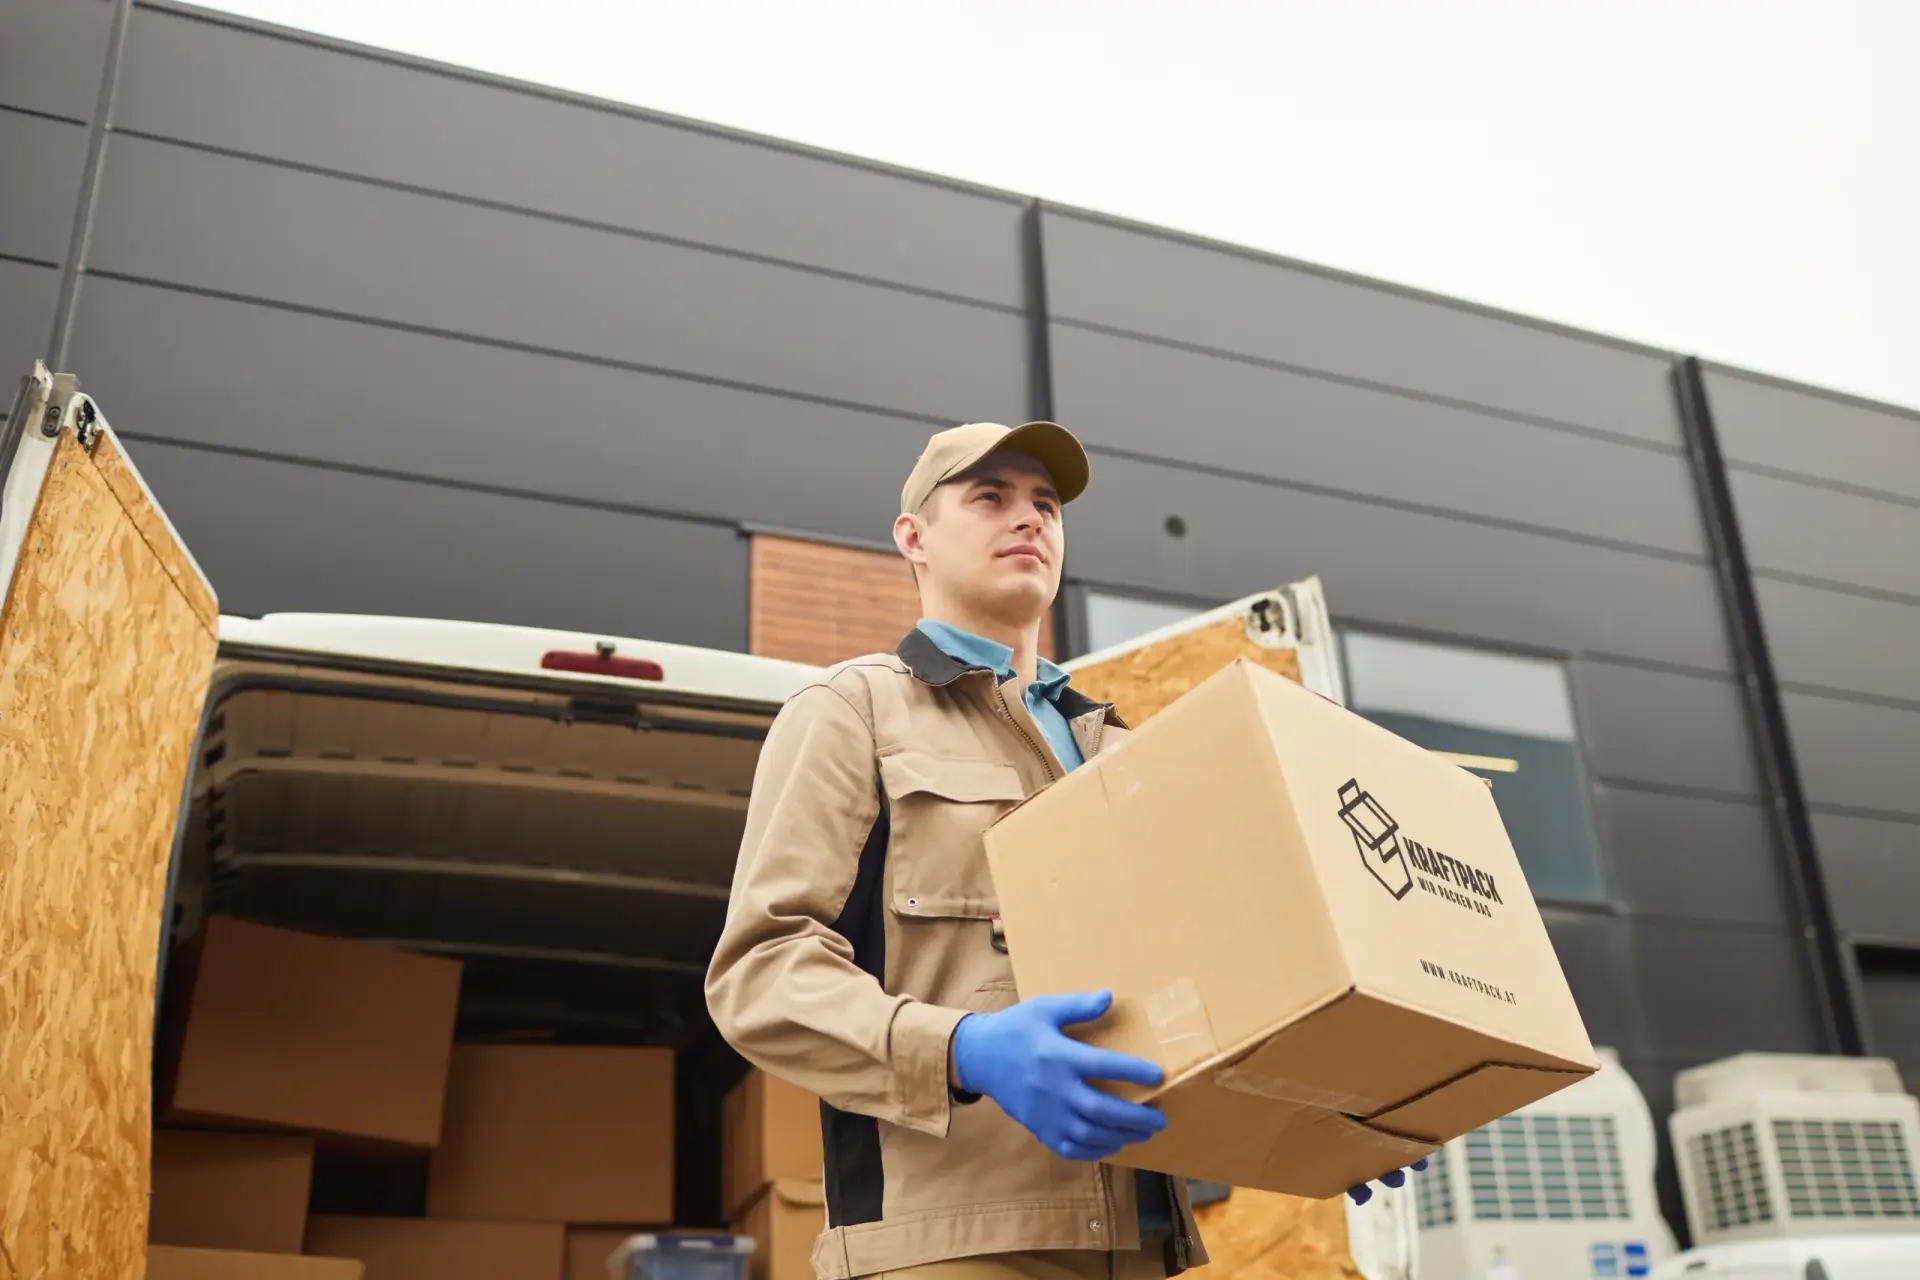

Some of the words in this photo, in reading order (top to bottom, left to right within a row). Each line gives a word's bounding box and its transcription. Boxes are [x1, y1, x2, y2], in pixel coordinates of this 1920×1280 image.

[1402, 836, 1504, 905] KRAFTPACK
[1417, 876, 1438, 896] WIR
[1437, 884, 1473, 910] PACKEN
[1473, 899, 1492, 918] DAS
[1420, 959, 1517, 1006] WWW.KRAFTPACK.AT
